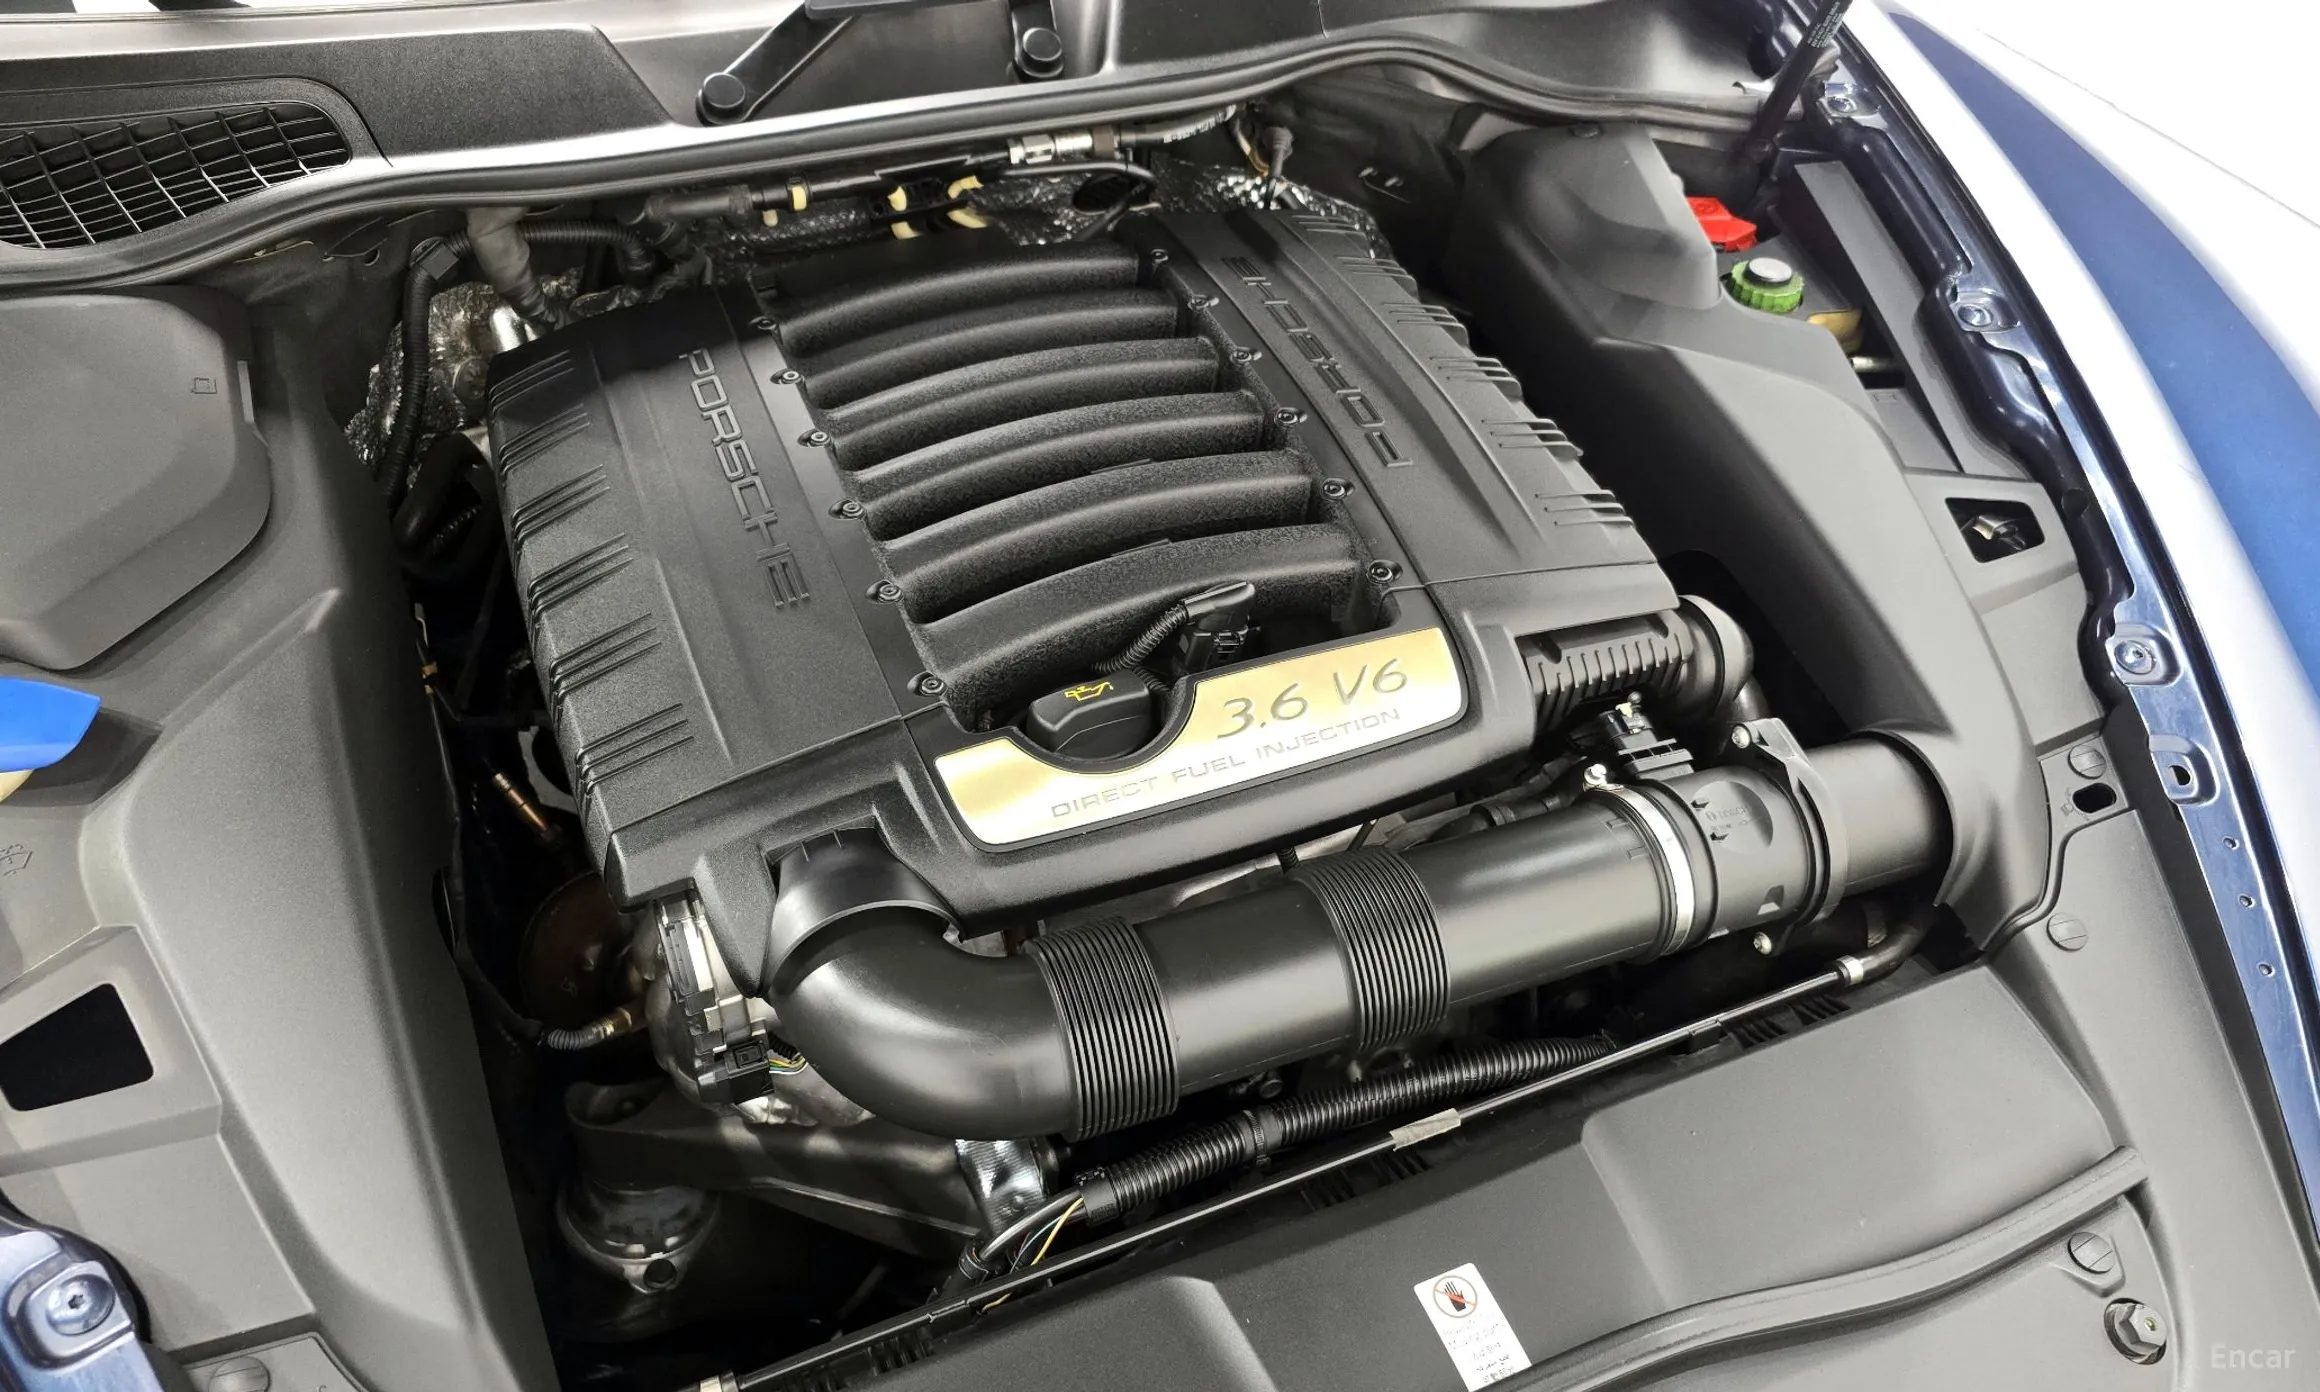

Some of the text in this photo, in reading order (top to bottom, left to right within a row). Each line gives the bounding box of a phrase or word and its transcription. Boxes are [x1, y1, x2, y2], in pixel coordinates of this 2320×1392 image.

[1221, 256, 1413, 468] PORSCHE
[679, 347, 810, 608] PORSCHE
[1051, 708, 1401, 819] DIRECT FUEL INJECTION
[1217, 658, 1408, 740] 3.6 V6
